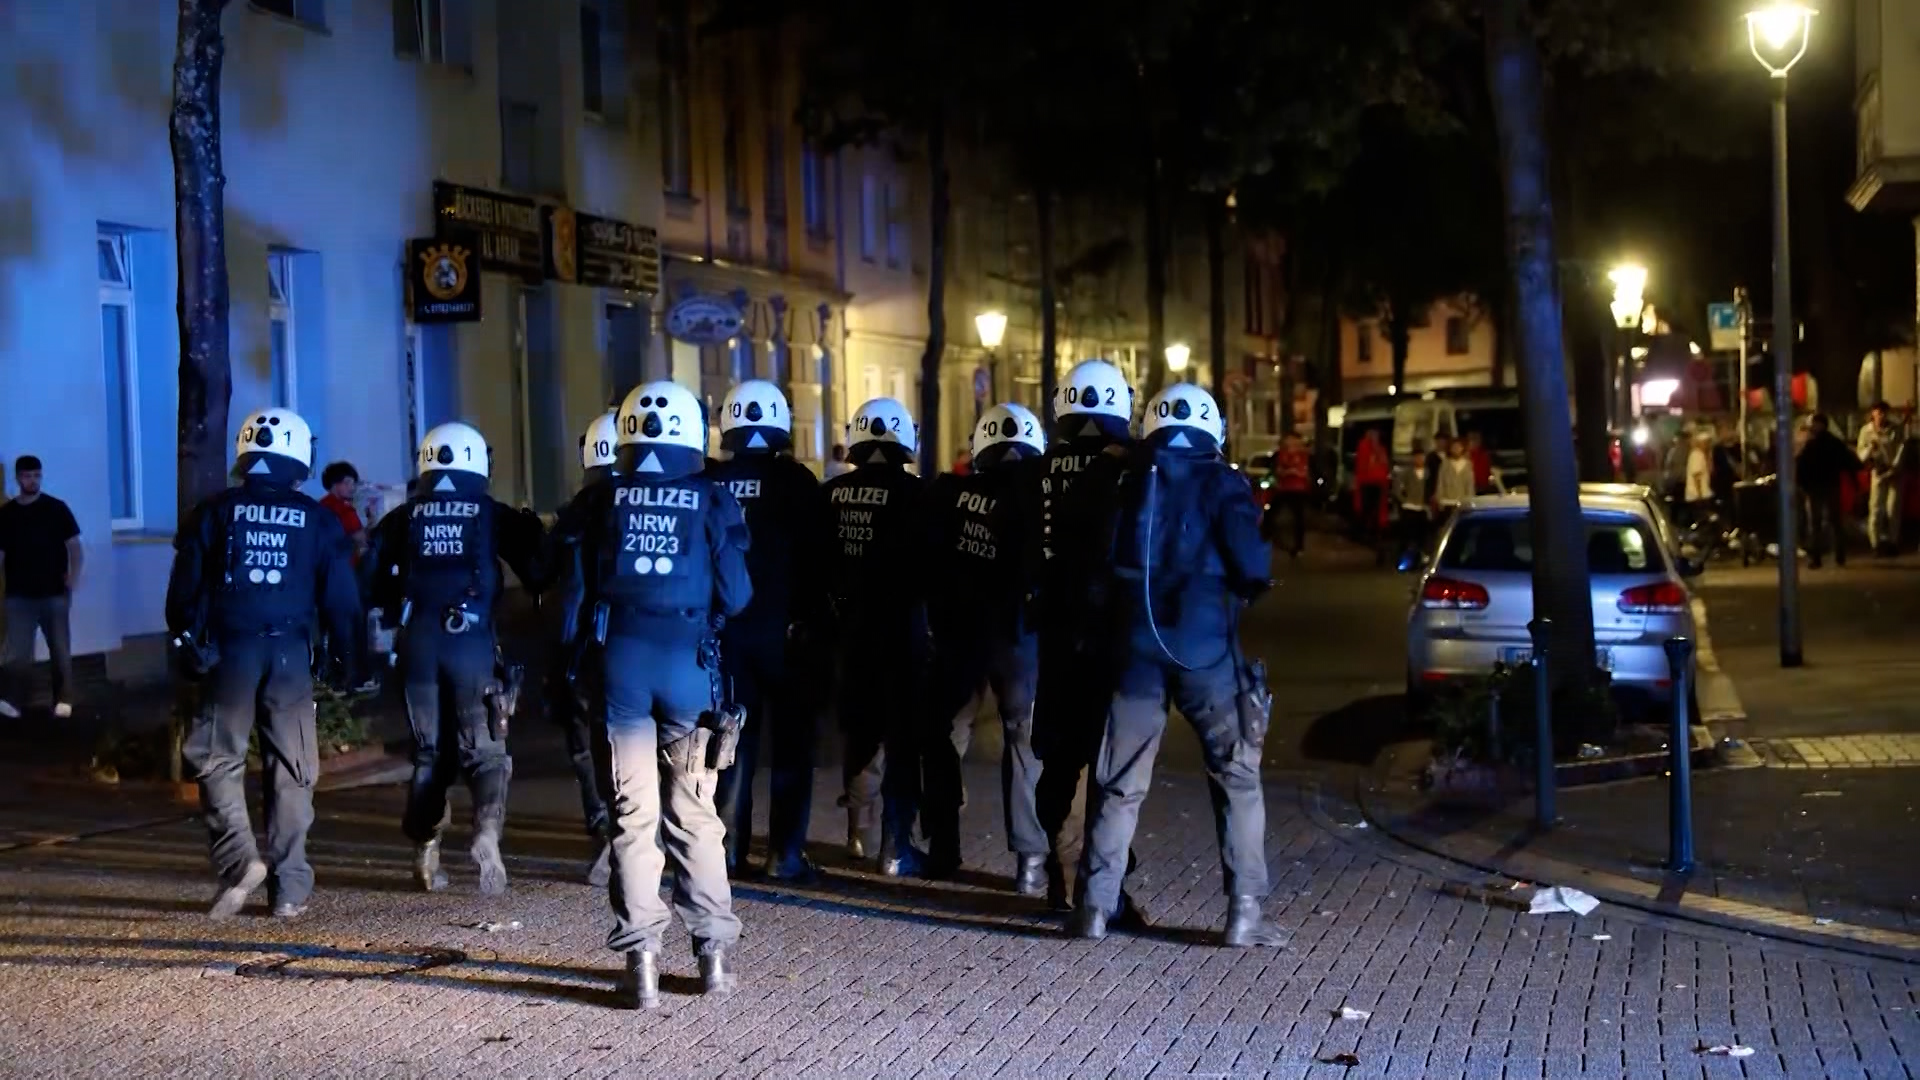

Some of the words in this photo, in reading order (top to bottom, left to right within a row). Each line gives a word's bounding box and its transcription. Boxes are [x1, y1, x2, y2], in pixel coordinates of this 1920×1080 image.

[1063, 387, 1077, 404] 10
[1105, 387, 1115, 406] 2
[729, 402, 742, 418] 10
[769, 401, 777, 417] 1
[1154, 401, 1169, 419] 10
[1200, 403, 1209, 420] 2
[623, 415, 637, 434] 10
[668, 415, 681, 436] 2
[855, 415, 868, 431] 10
[891, 416, 901, 433] 2
[983, 421, 997, 437] 10
[1024, 421, 1034, 437] 2
[284, 430, 291, 446] 1
[422, 446, 434, 462] 10
[463, 446, 471, 461] 1
[594, 440, 609, 457] 10
[1050, 455, 1097, 474] POLI
[614, 487, 699, 510] POLIZEI
[831, 486, 889, 506] POLIZEI
[233, 504, 305, 528] POLIZEI
[413, 500, 479, 518] POLIZEI
[840, 510, 872, 525] NRW
[628, 513, 677, 533] NRW
[245, 531, 287, 548] NRW
[424, 525, 463, 540] NRW
[837, 526, 873, 540] 21023
[423, 540, 463, 556] 21013
[624, 533, 679, 554] 21023
[844, 542, 863, 557] RH
[956, 537, 997, 561] 21023
[244, 551, 288, 568] 21013
